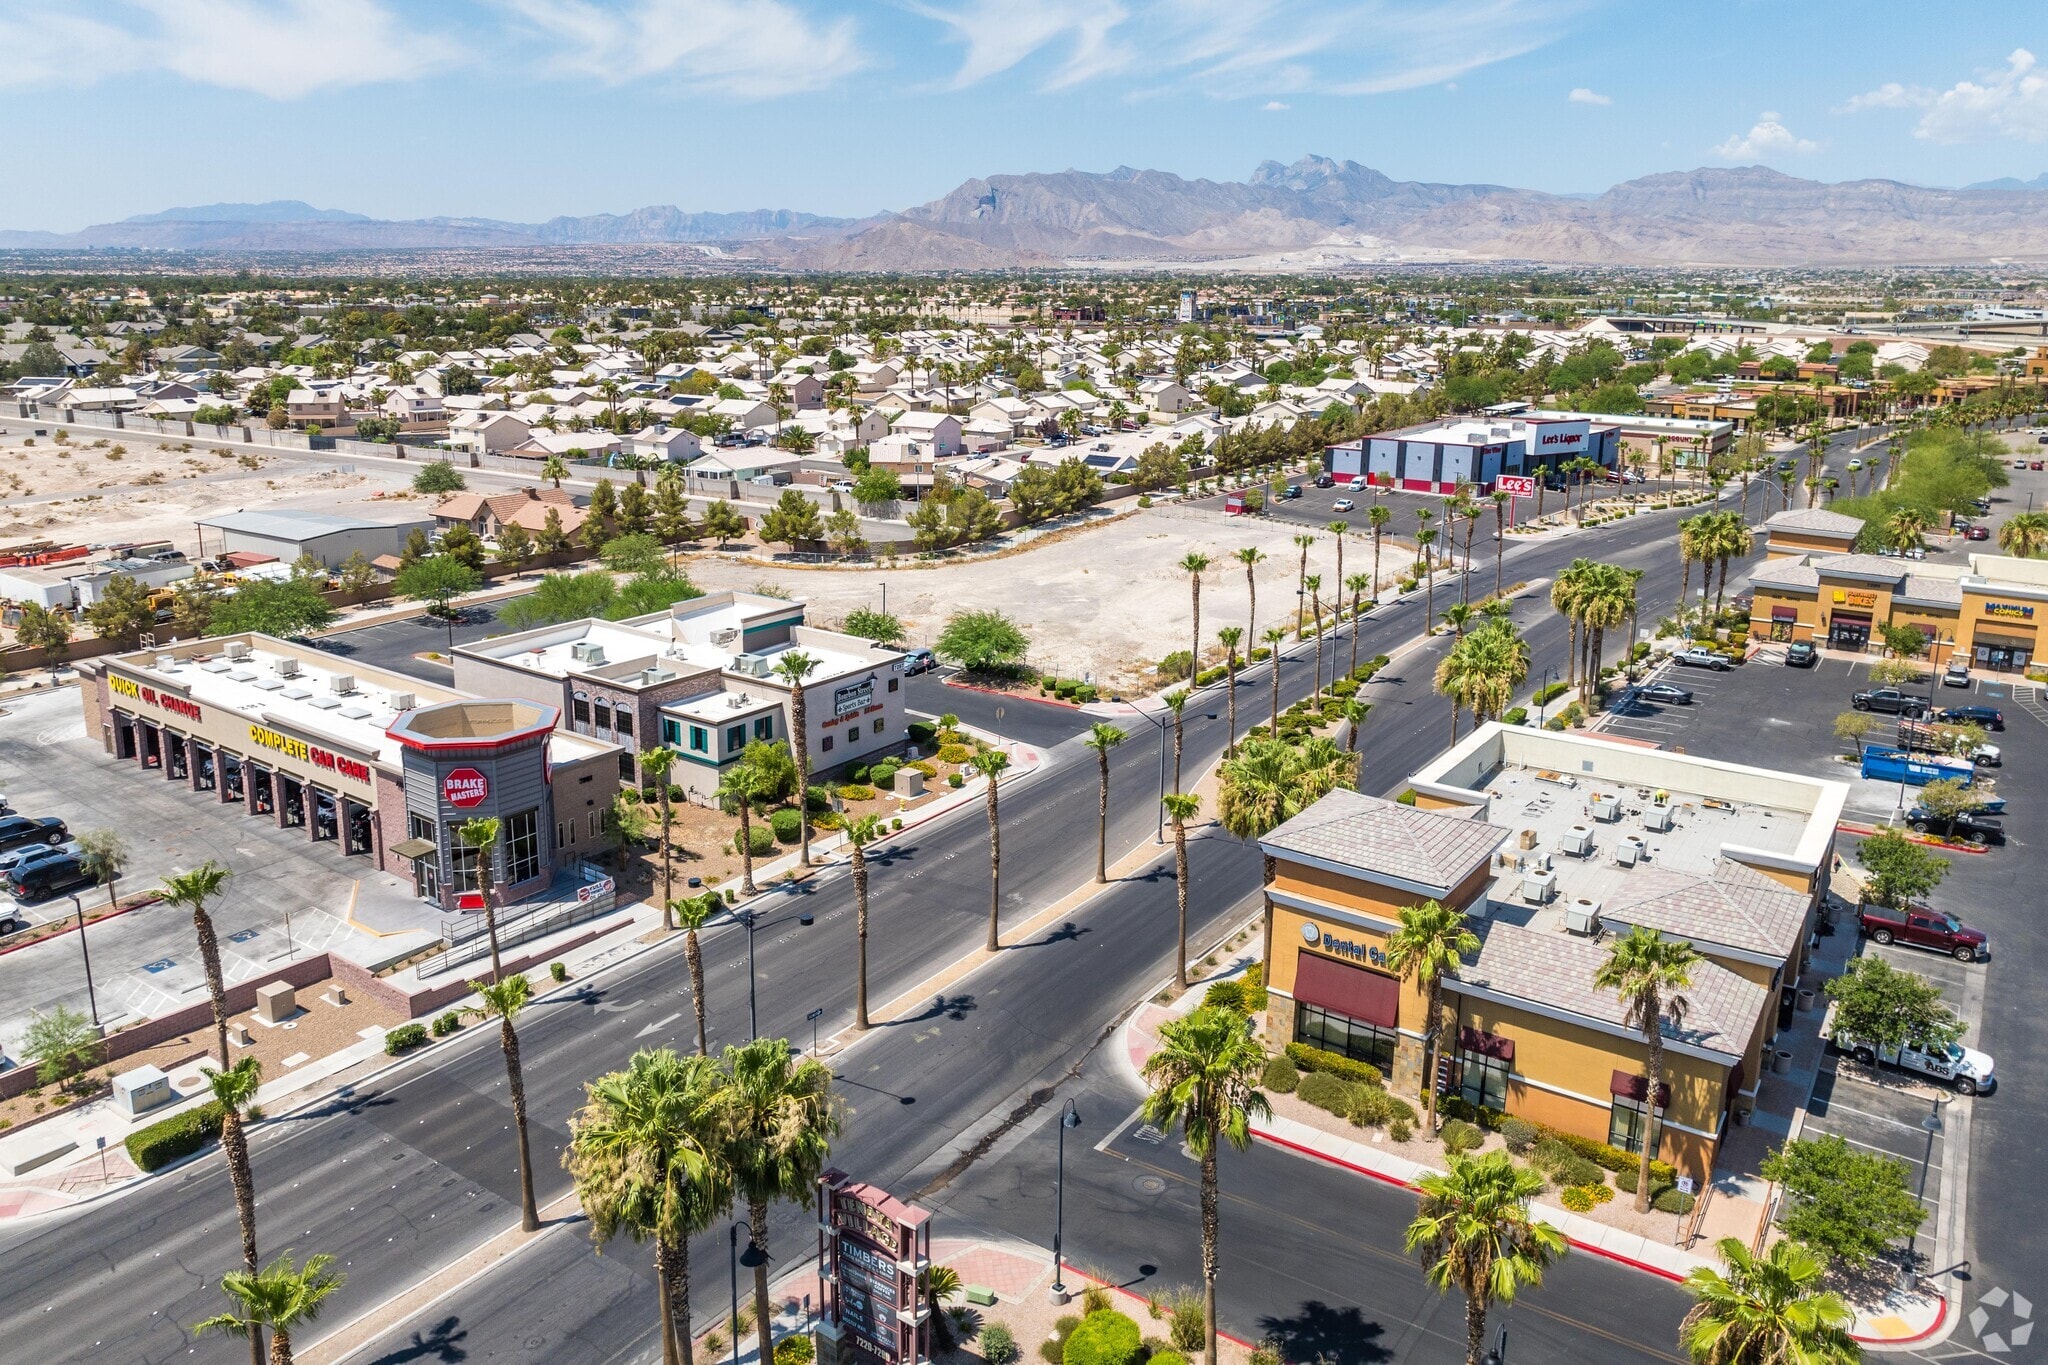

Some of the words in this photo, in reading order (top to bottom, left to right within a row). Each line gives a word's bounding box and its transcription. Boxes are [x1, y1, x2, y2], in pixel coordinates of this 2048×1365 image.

[1498, 477, 1532, 491] Lee's
[1848, 596, 1874, 607] BIKES
[1985, 602, 2034, 615] MAXIMUM
[1994, 608, 2024, 618] COMICS
[109, 675, 139, 699] QUICK
[141, 687, 158, 706] OIL
[160, 694, 202, 721] CHANGE
[249, 725, 309, 761] COMPLETE
[310, 747, 335, 770] CAR
[337, 757, 371, 783] CARE
[446, 778, 485, 790] BRAKE
[450, 788, 485, 801] MASTERS
[1323, 934, 1364, 956] Dental
[837, 1212, 898, 1253] VILLAGE
[841, 1240, 894, 1275] TIMBERS
[845, 1308, 863, 1322] NAILS
